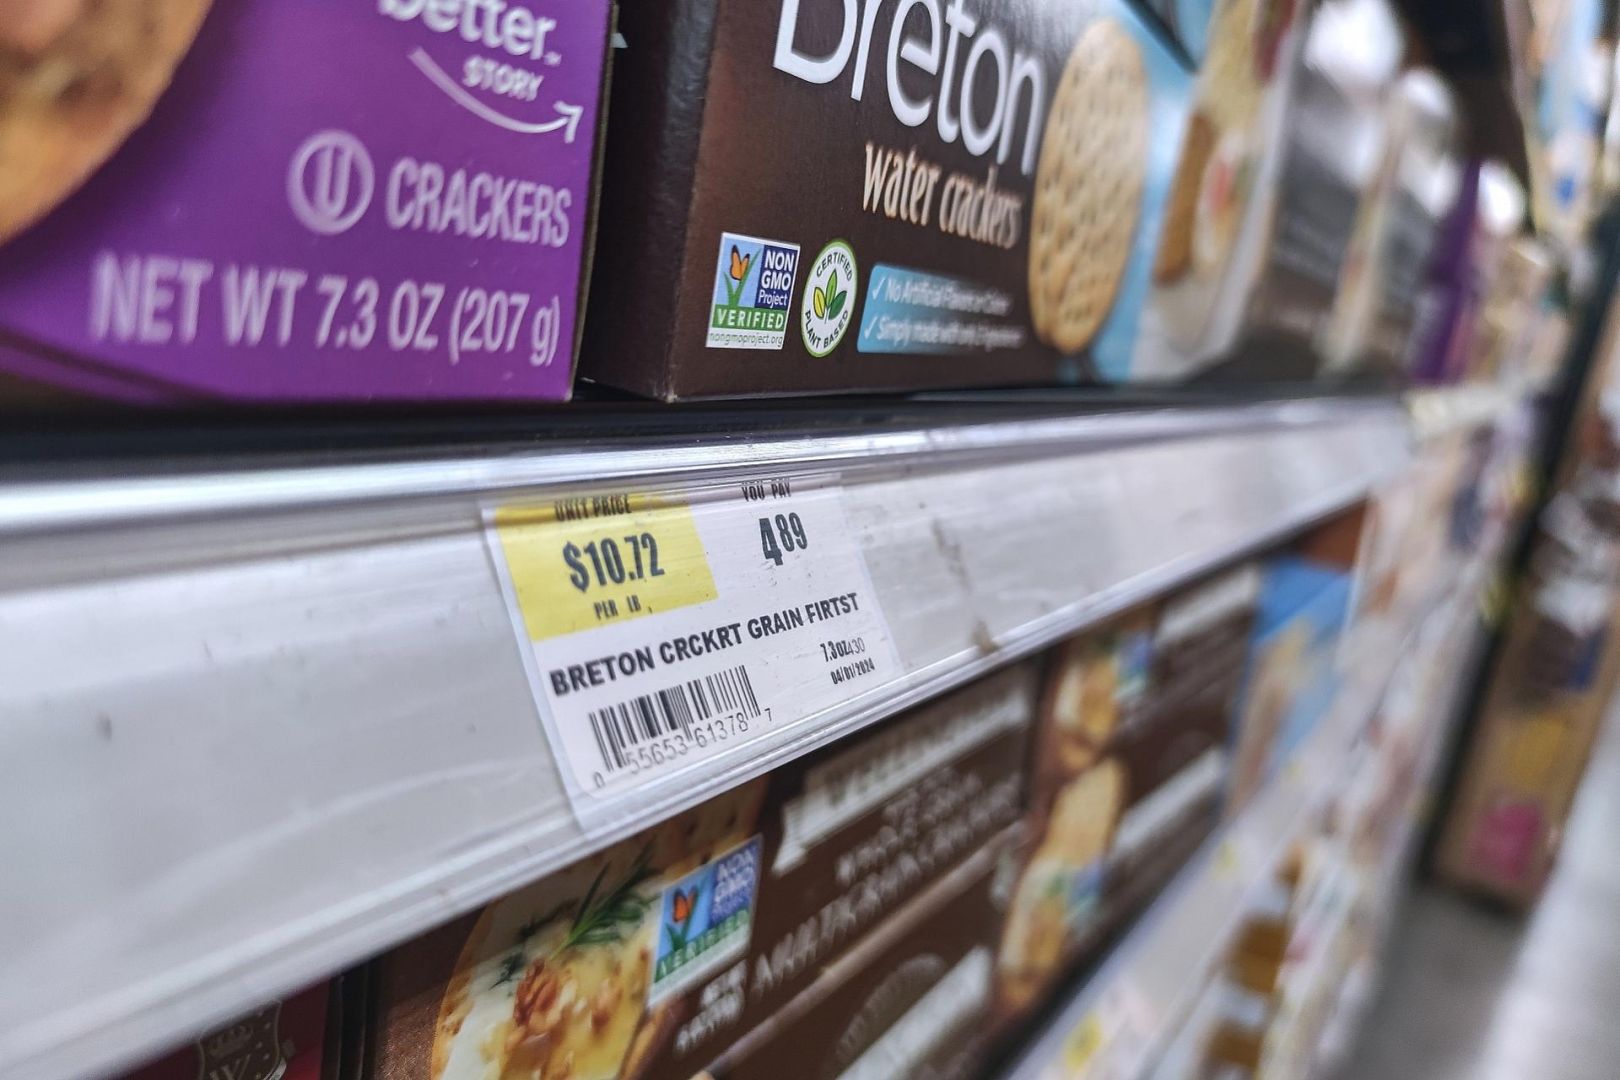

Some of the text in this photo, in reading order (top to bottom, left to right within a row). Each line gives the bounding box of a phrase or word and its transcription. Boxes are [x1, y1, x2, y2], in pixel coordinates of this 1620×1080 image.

[462, 55, 544, 101] STORY
[385, 156, 573, 248] CRACKERS
[863, 142, 1022, 249] water crackers
[765, 250, 795, 272] NON
[816, 252, 853, 282] CERTIFIED
[761, 271, 792, 291] GMO
[89, 250, 561, 367] NET WT 7.3 OZ (207 g)
[758, 291, 788, 309] Project
[716, 308, 785, 329] VERIFIED
[805, 310, 849, 348] PLANT BASED
[709, 332, 783, 347] nongmoproject.org
[741, 481, 792, 502] YOU PAY
[554, 493, 632, 522] UNIT PRICE
[562, 532, 665, 593] $10.72
[549, 592, 860, 697] BRETON CRCKRT GRAIN FIRTST
[830, 657, 876, 685] 04/01/2024
[626, 734, 689, 775] 55653
[694, 712, 749, 748] 61378
